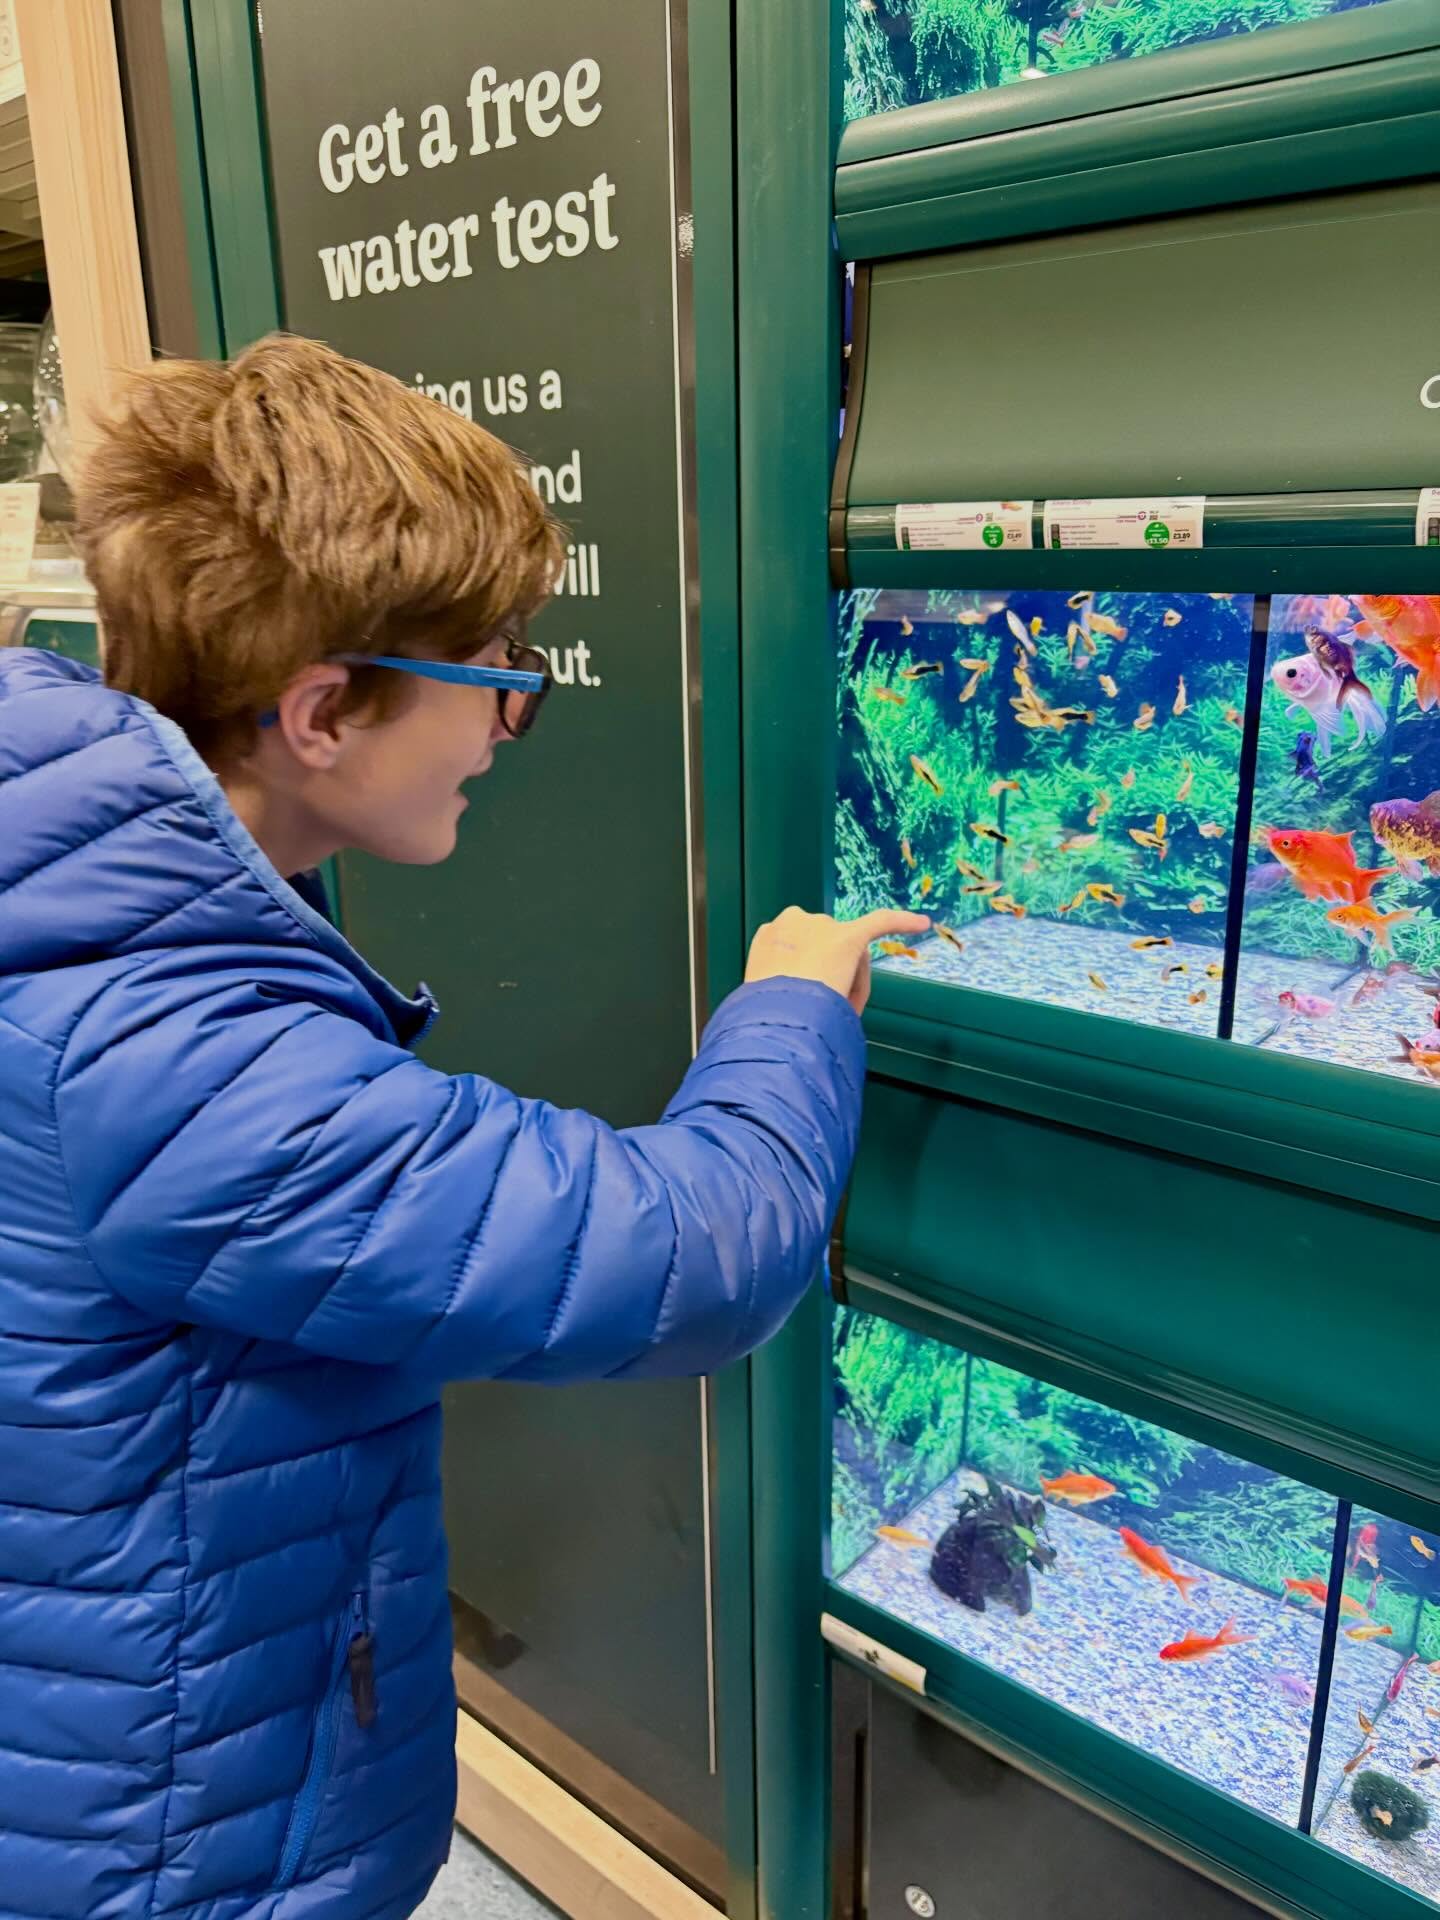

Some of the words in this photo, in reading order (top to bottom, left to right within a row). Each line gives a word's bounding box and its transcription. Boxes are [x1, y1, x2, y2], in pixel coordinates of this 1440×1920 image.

[319, 107, 409, 194] Get
[418, 104, 458, 169] a
[466, 58, 602, 156] free
[318, 214, 479, 301] water
[491, 172, 620, 269] test
[482, 373, 528, 416] us
[539, 369, 562, 410] a
[526, 449, 582, 504] nd
[534, 640, 601, 687] ut.
